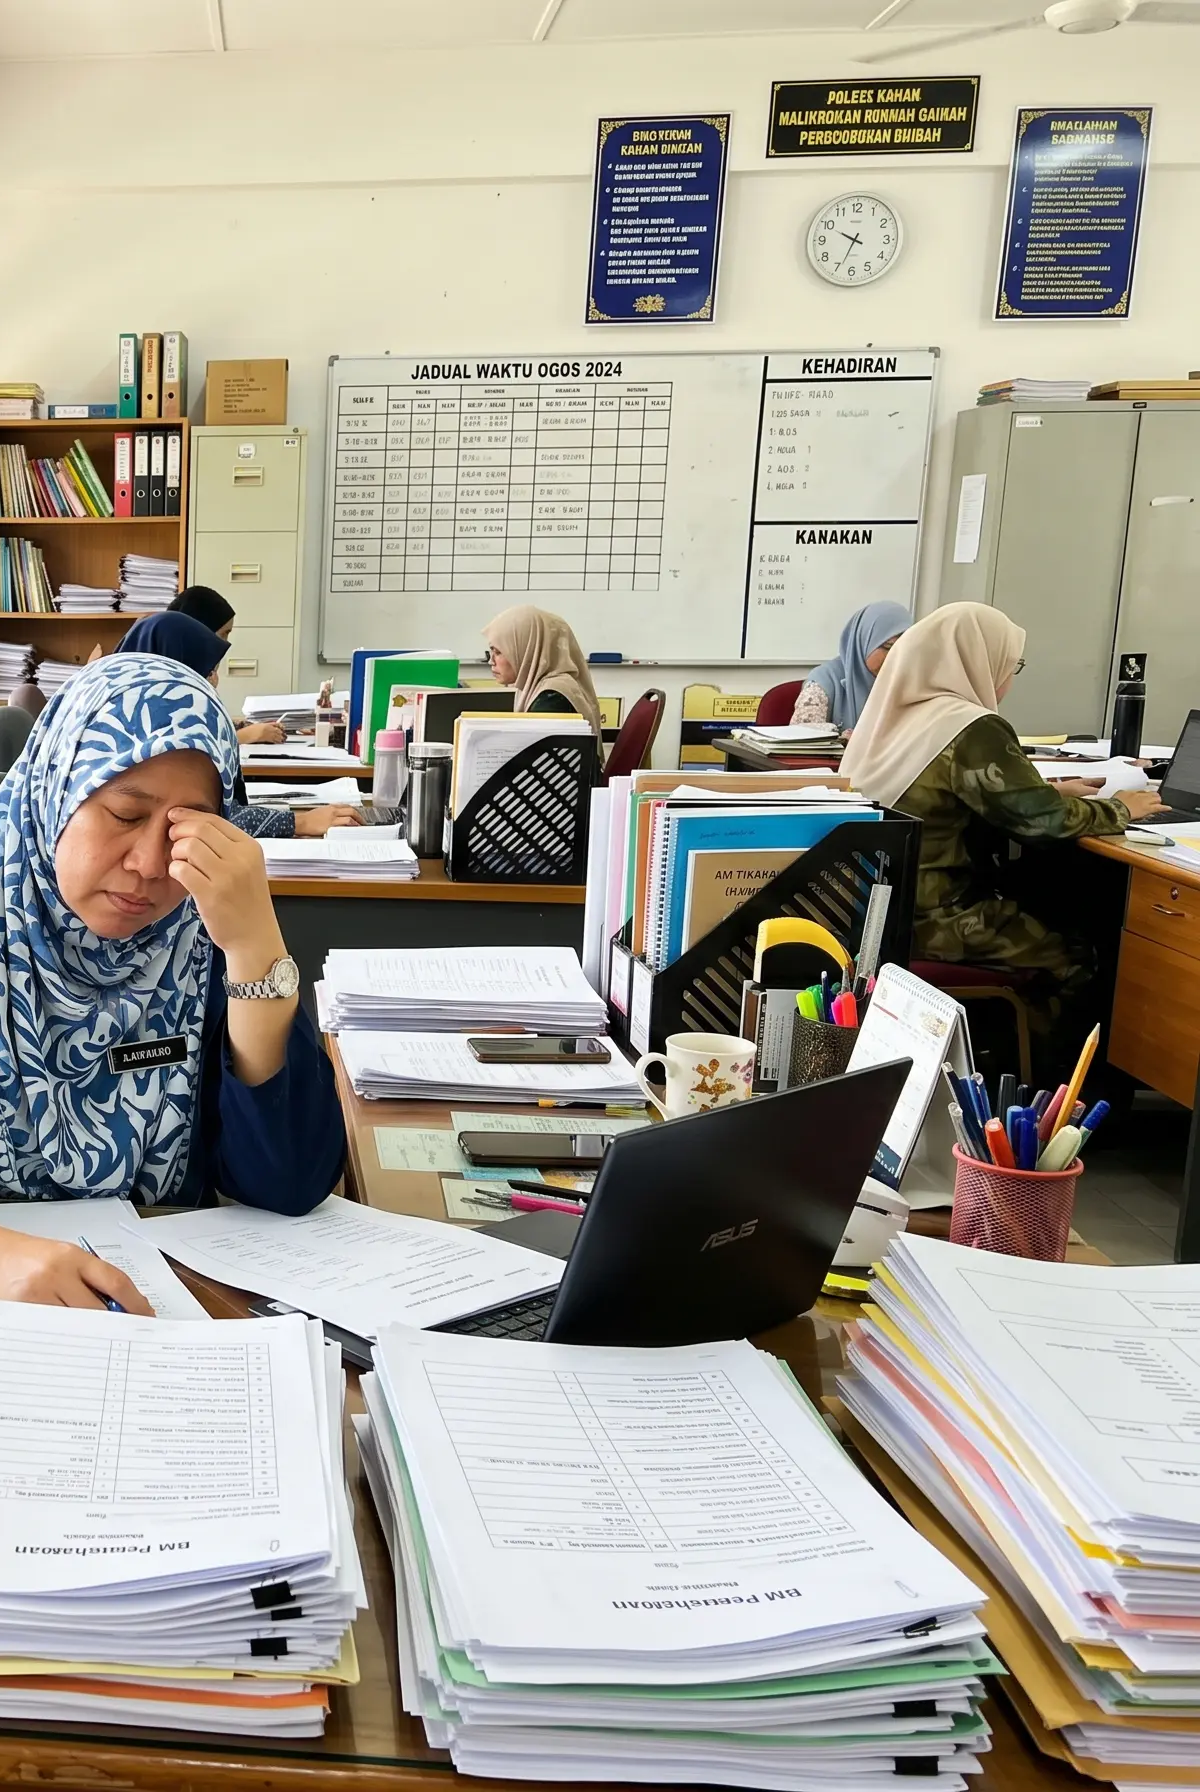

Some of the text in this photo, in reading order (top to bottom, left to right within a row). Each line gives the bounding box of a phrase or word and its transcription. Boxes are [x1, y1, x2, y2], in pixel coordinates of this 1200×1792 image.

[836, 207, 846, 217] 11
[852, 202, 863, 213] 12
[871, 206, 876, 217] 1
[824, 219, 835, 230] 10
[880, 218, 888, 229] 2
[818, 235, 826, 246] 9
[882, 234, 891, 245] 3
[821, 252, 829, 262] 8
[877, 250, 884, 260] 4
[834, 262, 842, 272] 7
[847, 266, 856, 277] 6
[863, 261, 872, 272] 5
[411, 361, 623, 380] JADUAL WAKTU OGOS 2024
[801, 357, 898, 375] KEHADIRAN
[795, 529, 873, 545] KANAKAN
[714, 870, 733, 880] AM
[700, 1218, 759, 1252] ASUS
